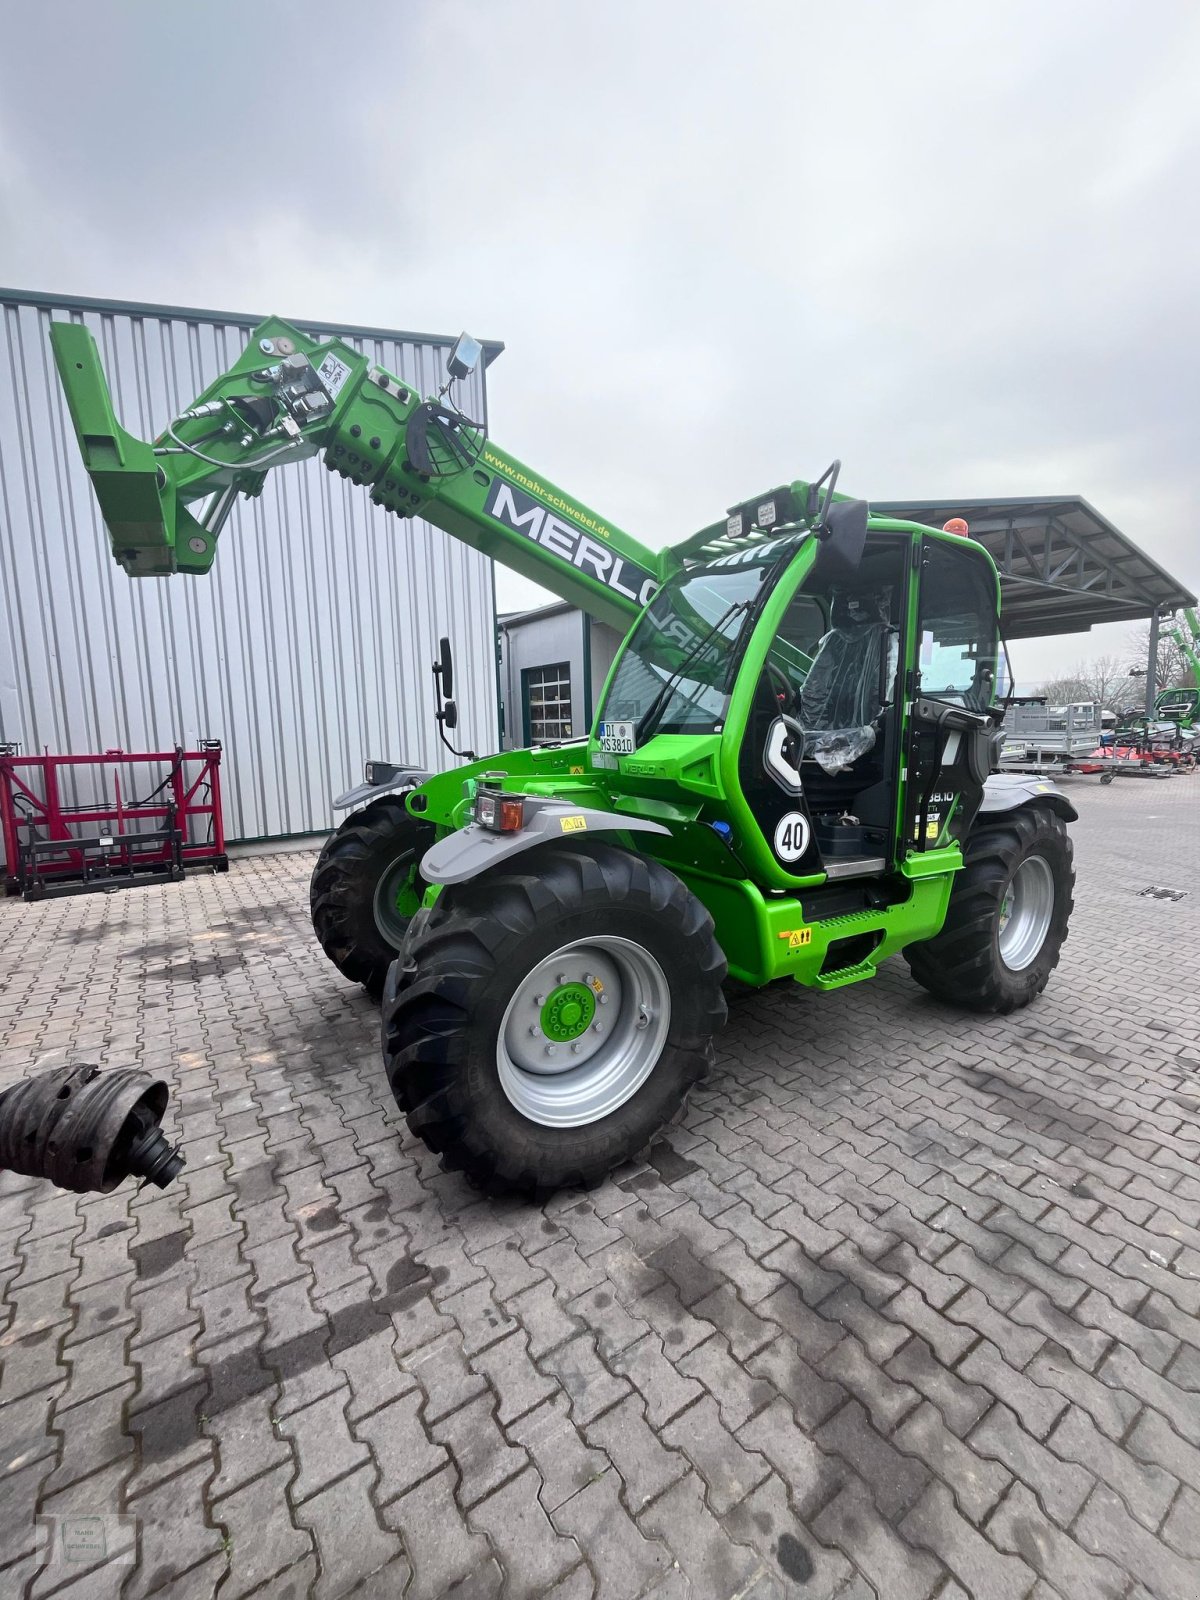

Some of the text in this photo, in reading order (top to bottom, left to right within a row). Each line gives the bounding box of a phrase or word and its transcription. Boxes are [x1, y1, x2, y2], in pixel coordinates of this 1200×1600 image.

[484, 451, 610, 539] www.mahr-schwebel.de
[606, 725, 615, 737] DI
[782, 822, 803, 851] 40
